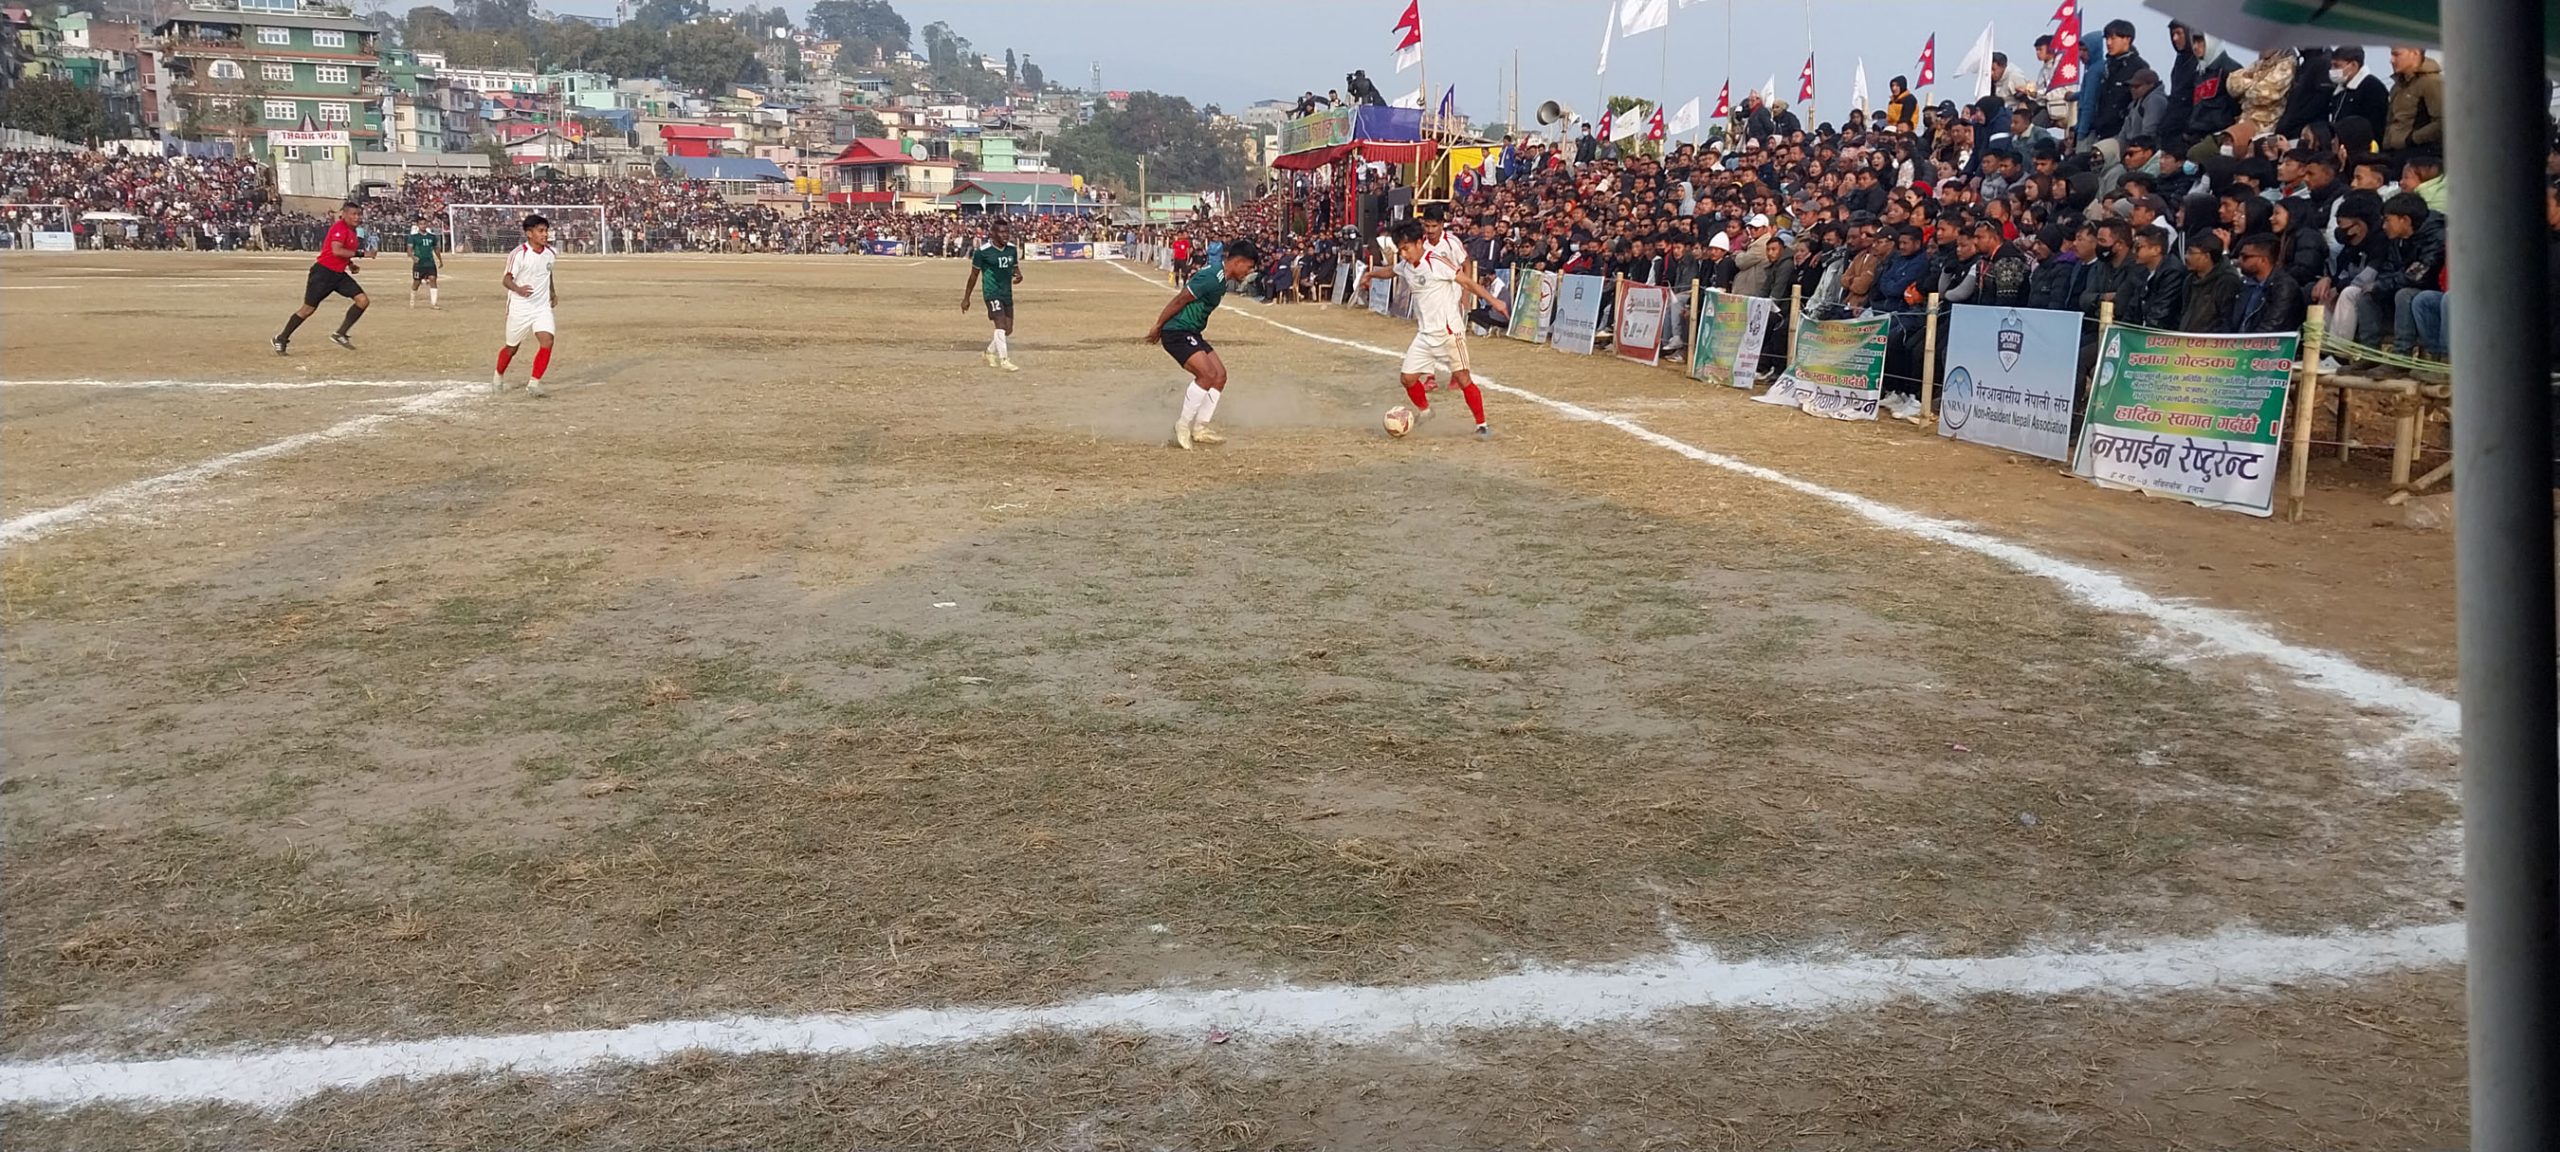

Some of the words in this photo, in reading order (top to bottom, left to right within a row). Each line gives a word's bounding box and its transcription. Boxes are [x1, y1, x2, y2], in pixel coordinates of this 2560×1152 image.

[282, 132, 315, 140] THANK
[318, 132, 338, 140] YOU
[998, 257, 1009, 268] 12
[990, 300, 1001, 312] 12
[1186, 335, 1198, 346] 3
[1999, 332, 2021, 344] SPORTS
[2128, 352, 2169, 366] इलाम
[1976, 380, 2022, 405] गैरआवासीय
[2024, 389, 2051, 411] नेपाली
[2053, 395, 2070, 414] संघ
[1973, 403, 2011, 425] Non-Resident
[2012, 412, 2031, 429] Nepali
[2032, 415, 2068, 435] Association
[2167, 411, 2213, 429] स्वागत
